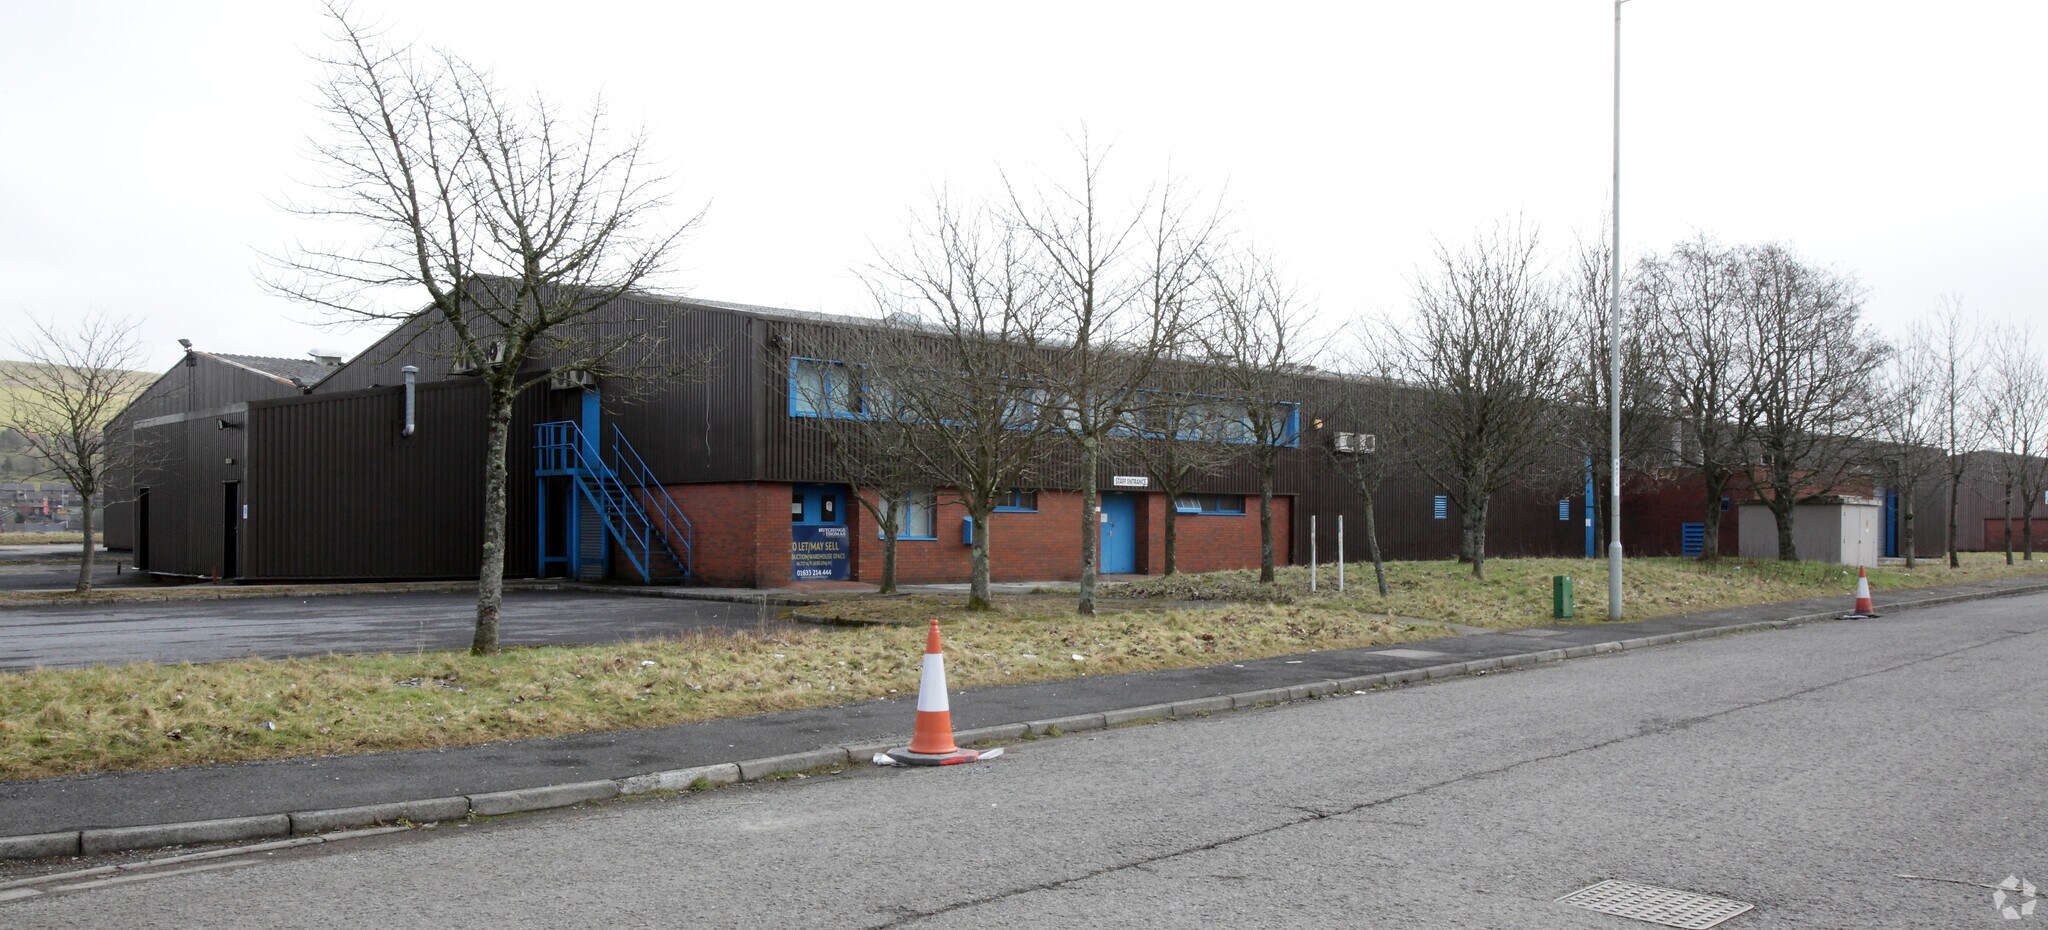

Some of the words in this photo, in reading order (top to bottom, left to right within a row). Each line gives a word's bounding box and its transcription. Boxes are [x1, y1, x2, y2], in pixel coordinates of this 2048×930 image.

[792, 542, 797, 551] O
[798, 541, 824, 553] LET/MAY
[825, 541, 839, 550] SELL
